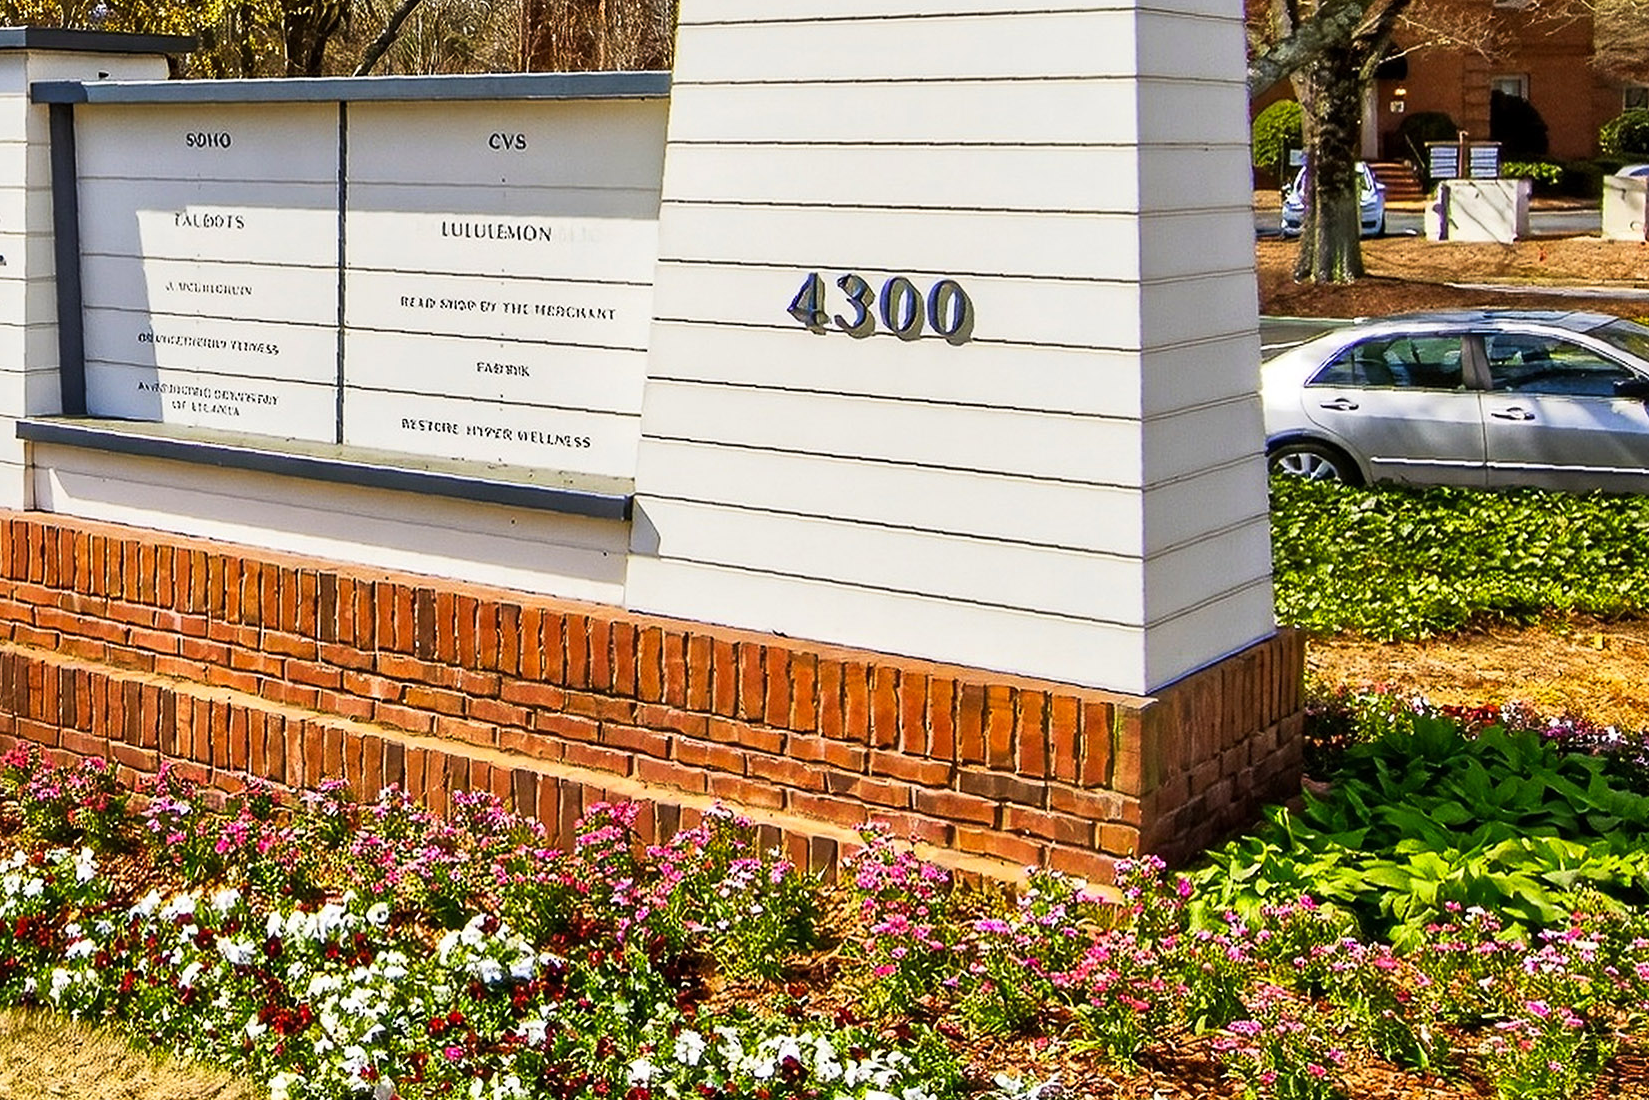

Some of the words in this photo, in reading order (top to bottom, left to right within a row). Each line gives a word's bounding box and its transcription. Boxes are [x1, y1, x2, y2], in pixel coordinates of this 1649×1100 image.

[185, 131, 232, 149] SOHO
[488, 133, 527, 150] CVS
[175, 212, 245, 230] TALBOTS
[441, 220, 553, 242] LULULEMON
[503, 302, 530, 315] THE
[787, 272, 974, 345] 4300
